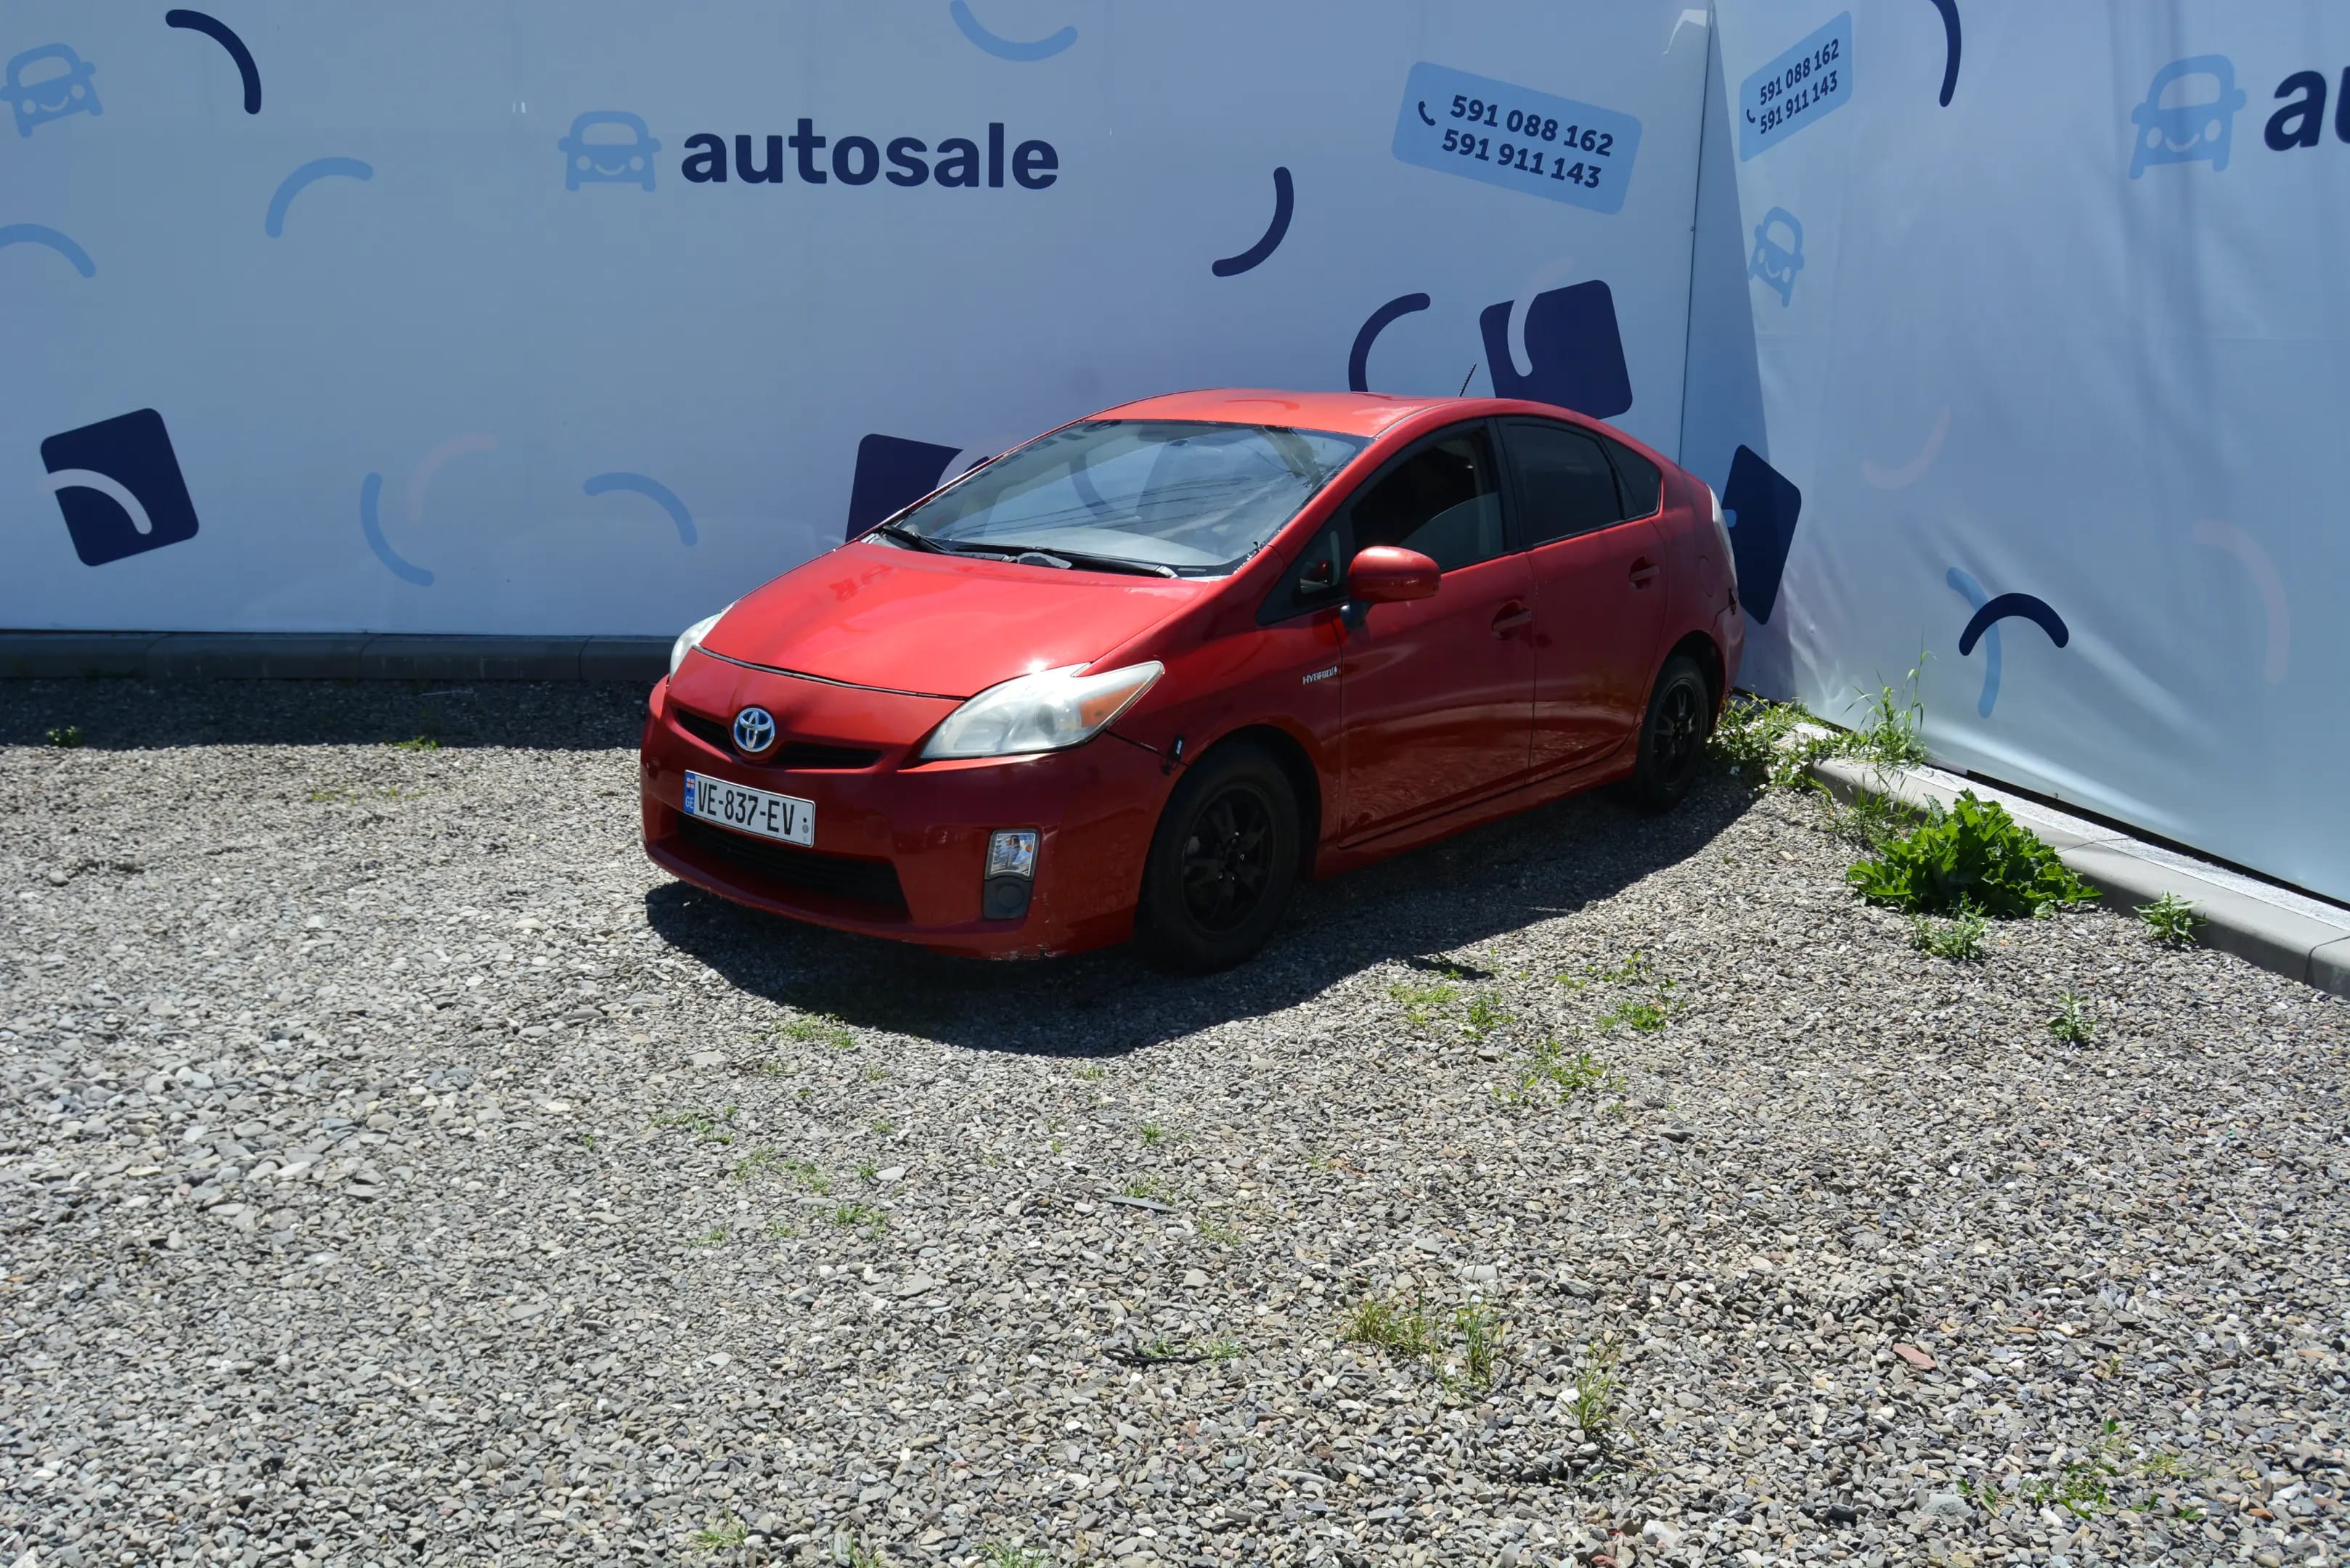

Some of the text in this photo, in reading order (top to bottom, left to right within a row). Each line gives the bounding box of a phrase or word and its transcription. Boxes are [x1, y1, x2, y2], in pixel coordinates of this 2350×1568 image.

[1761, 38, 1839, 105] 591 088 162
[1761, 70, 1837, 134] 591 911 143
[681, 118, 1058, 189] autosale
[1451, 94, 1613, 157] 591 088 162
[1442, 128, 1602, 189] 591 911 143
[1302, 667, 1334, 685] HYBRID
[685, 796, 694, 809] GE
[698, 780, 794, 836] VE-837-EV
